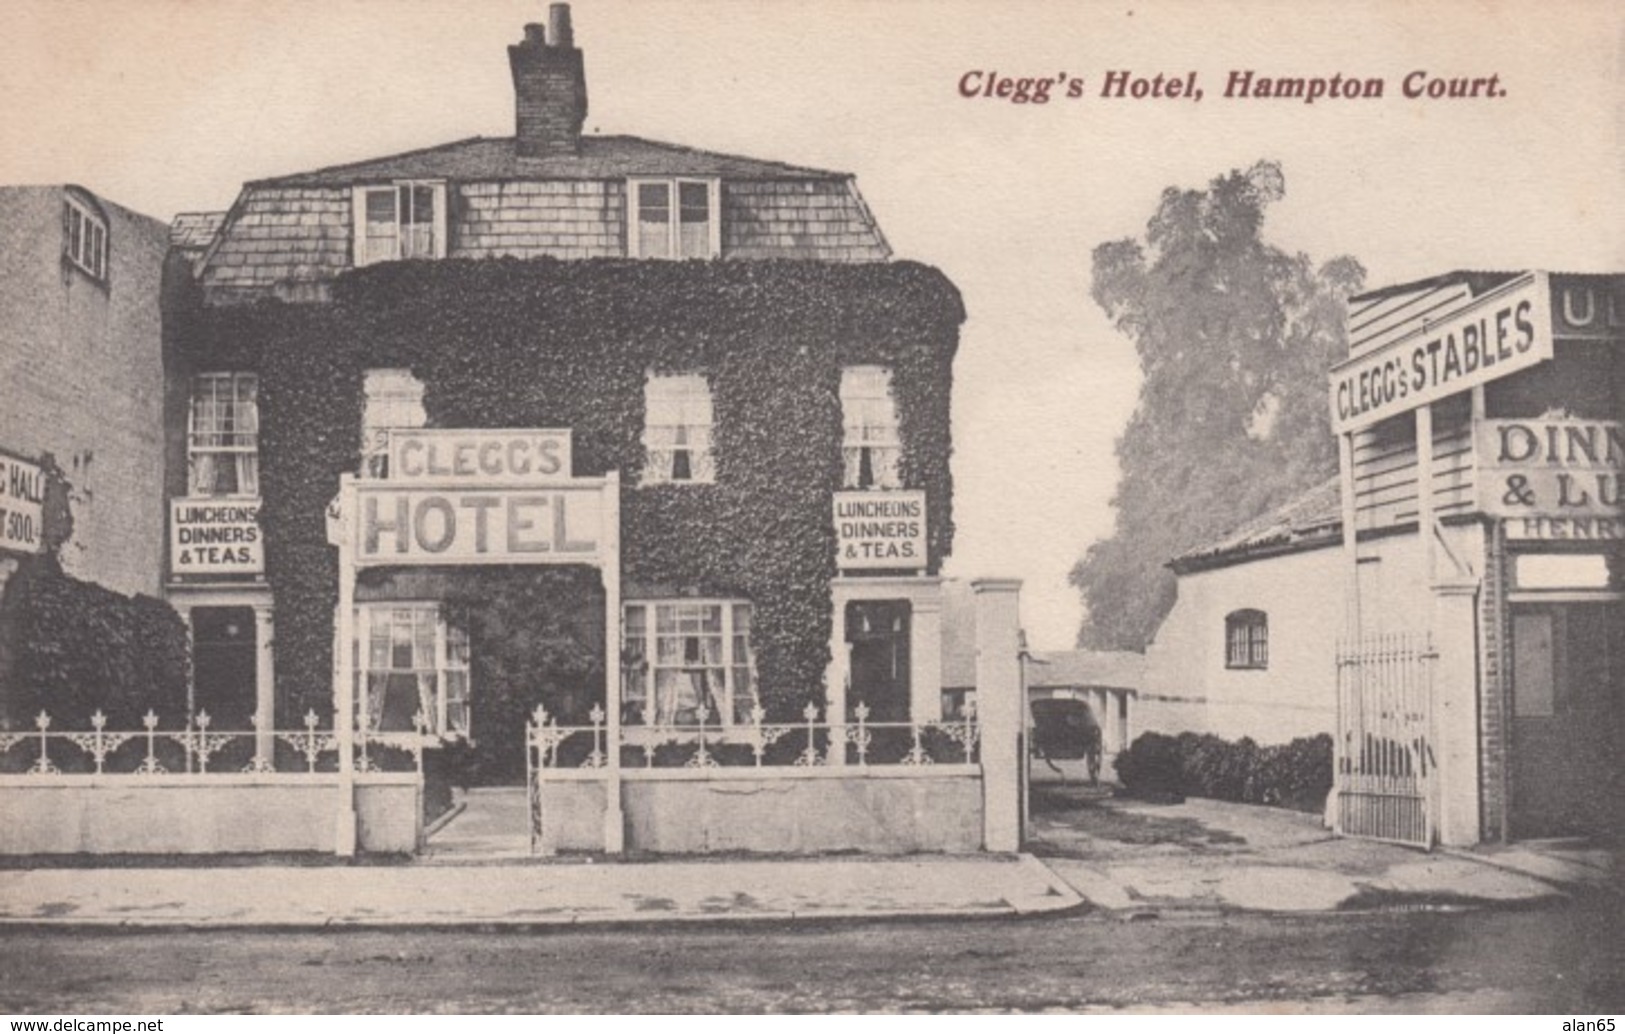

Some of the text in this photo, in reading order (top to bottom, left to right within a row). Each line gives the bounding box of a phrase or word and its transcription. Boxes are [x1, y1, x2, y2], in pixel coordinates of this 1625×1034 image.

[1411, 299, 1535, 391] STABLES
[399, 439, 562, 476] CLEGG'S
[1502, 473, 1536, 507] &
[175, 506, 257, 524] LUNCHEONS
[838, 500, 921, 518] LUNCHEONS
[365, 495, 597, 554] HOTEL
[841, 521, 920, 539] DINNERS
[178, 526, 257, 545] DINNERS
[179, 546, 256, 565] & TEAS.
[845, 541, 919, 560] & TEAS.
